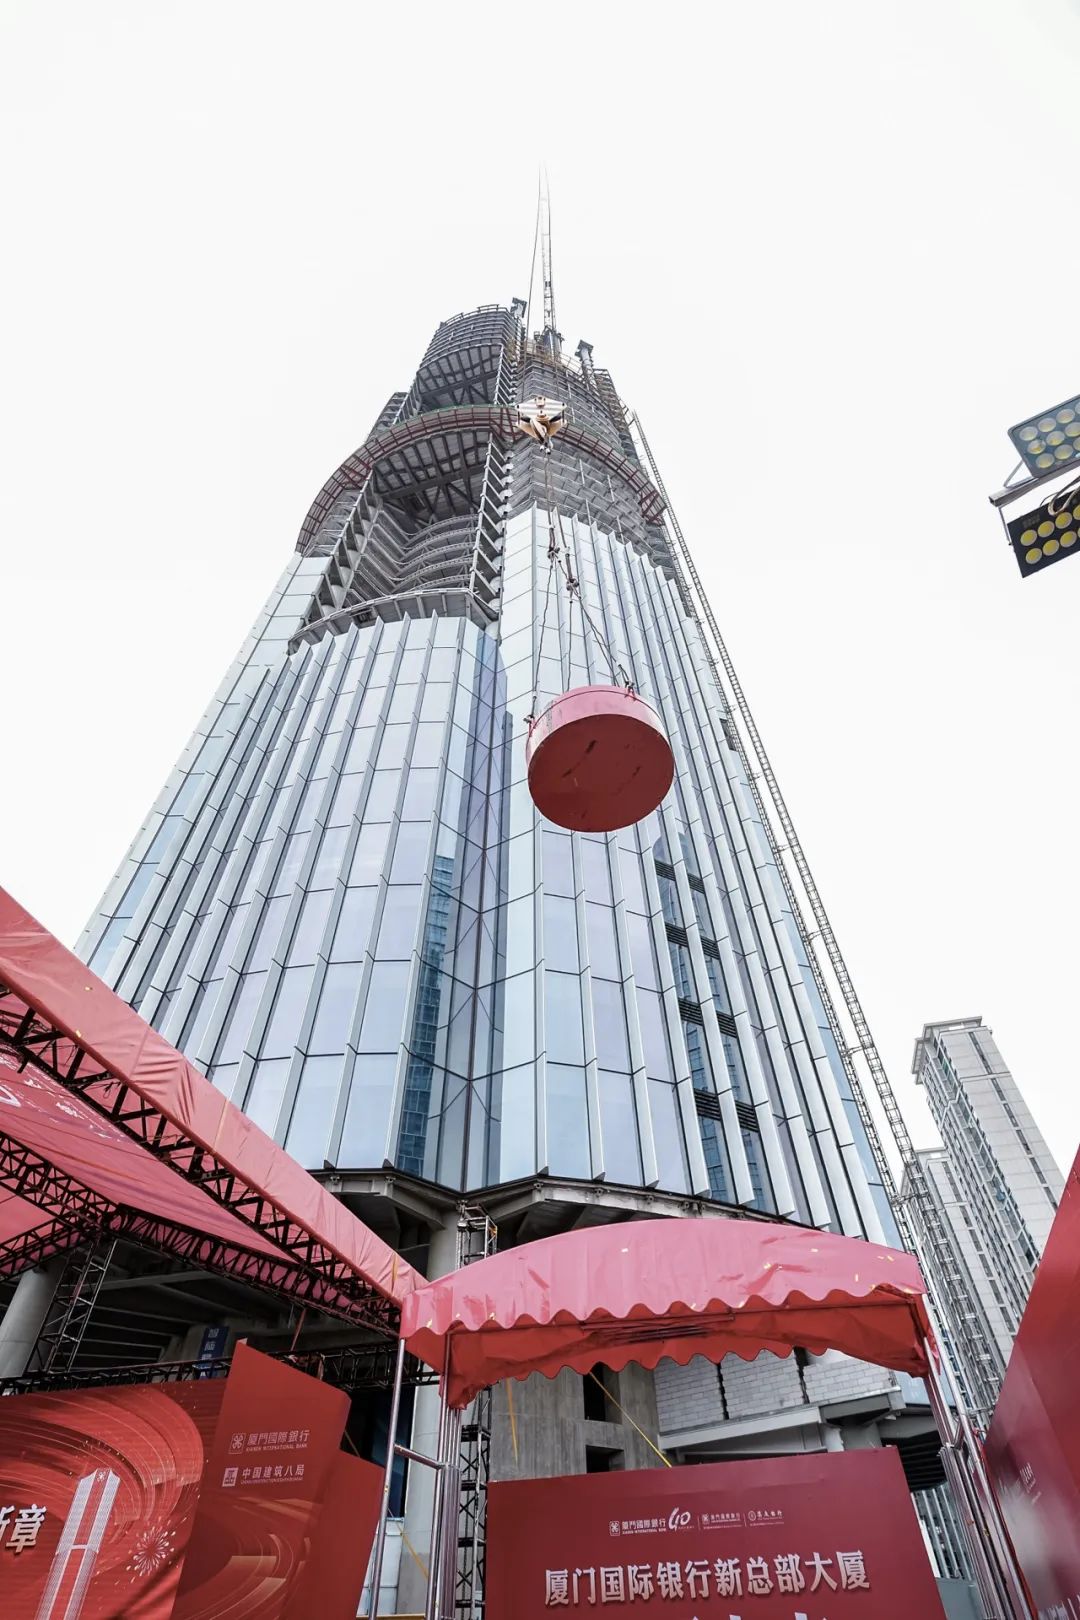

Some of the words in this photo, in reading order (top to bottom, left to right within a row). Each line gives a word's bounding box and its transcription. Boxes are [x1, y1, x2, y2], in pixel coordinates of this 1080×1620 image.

[242, 1464, 304, 1479] 中国建筑八局
[545, 1550, 870, 1605] 厦门国际银行新总部大厦
